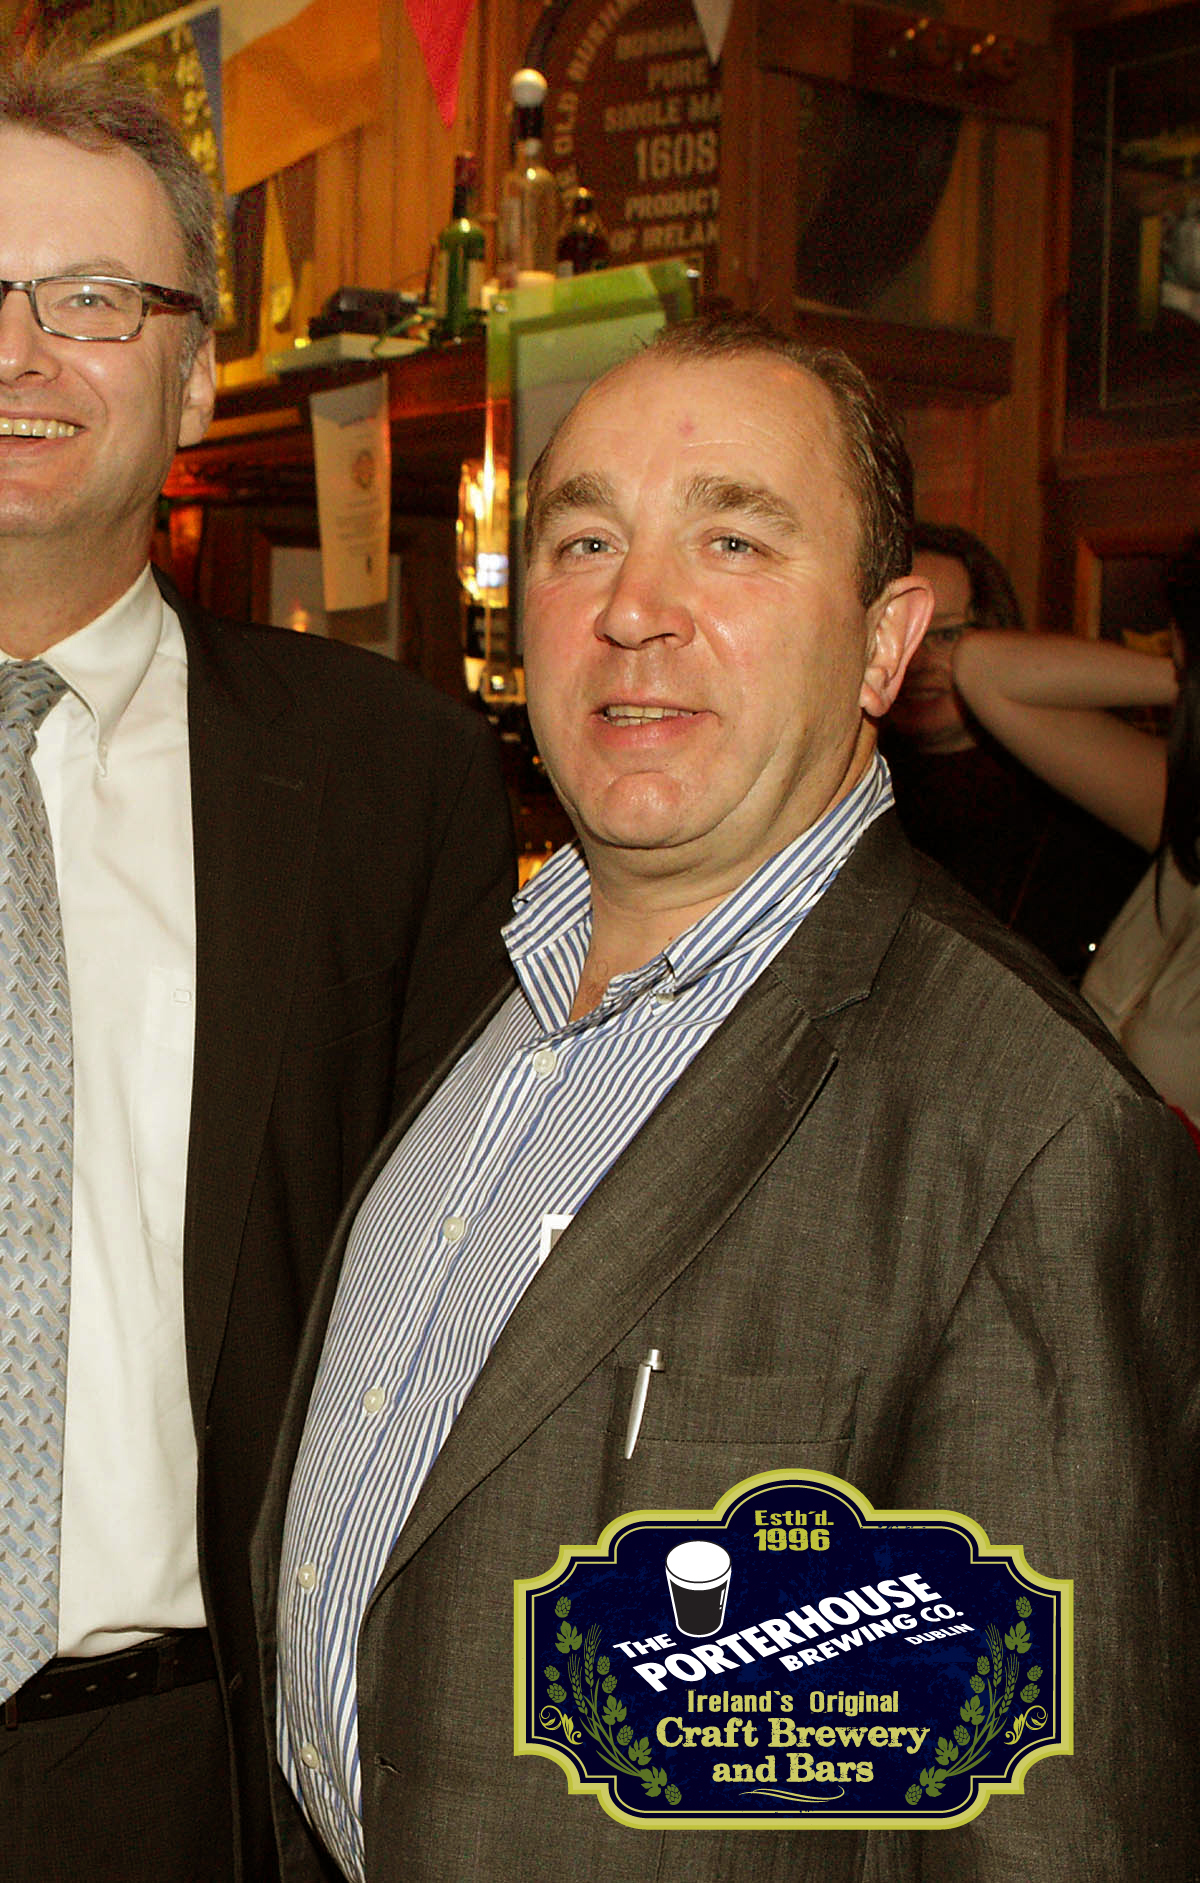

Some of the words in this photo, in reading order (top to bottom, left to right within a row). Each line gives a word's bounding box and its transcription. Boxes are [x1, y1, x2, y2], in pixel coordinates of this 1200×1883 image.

[647, 57, 708, 91] PURE
[603, 97, 681, 133] SINGLE
[608, 229, 638, 254] OF
